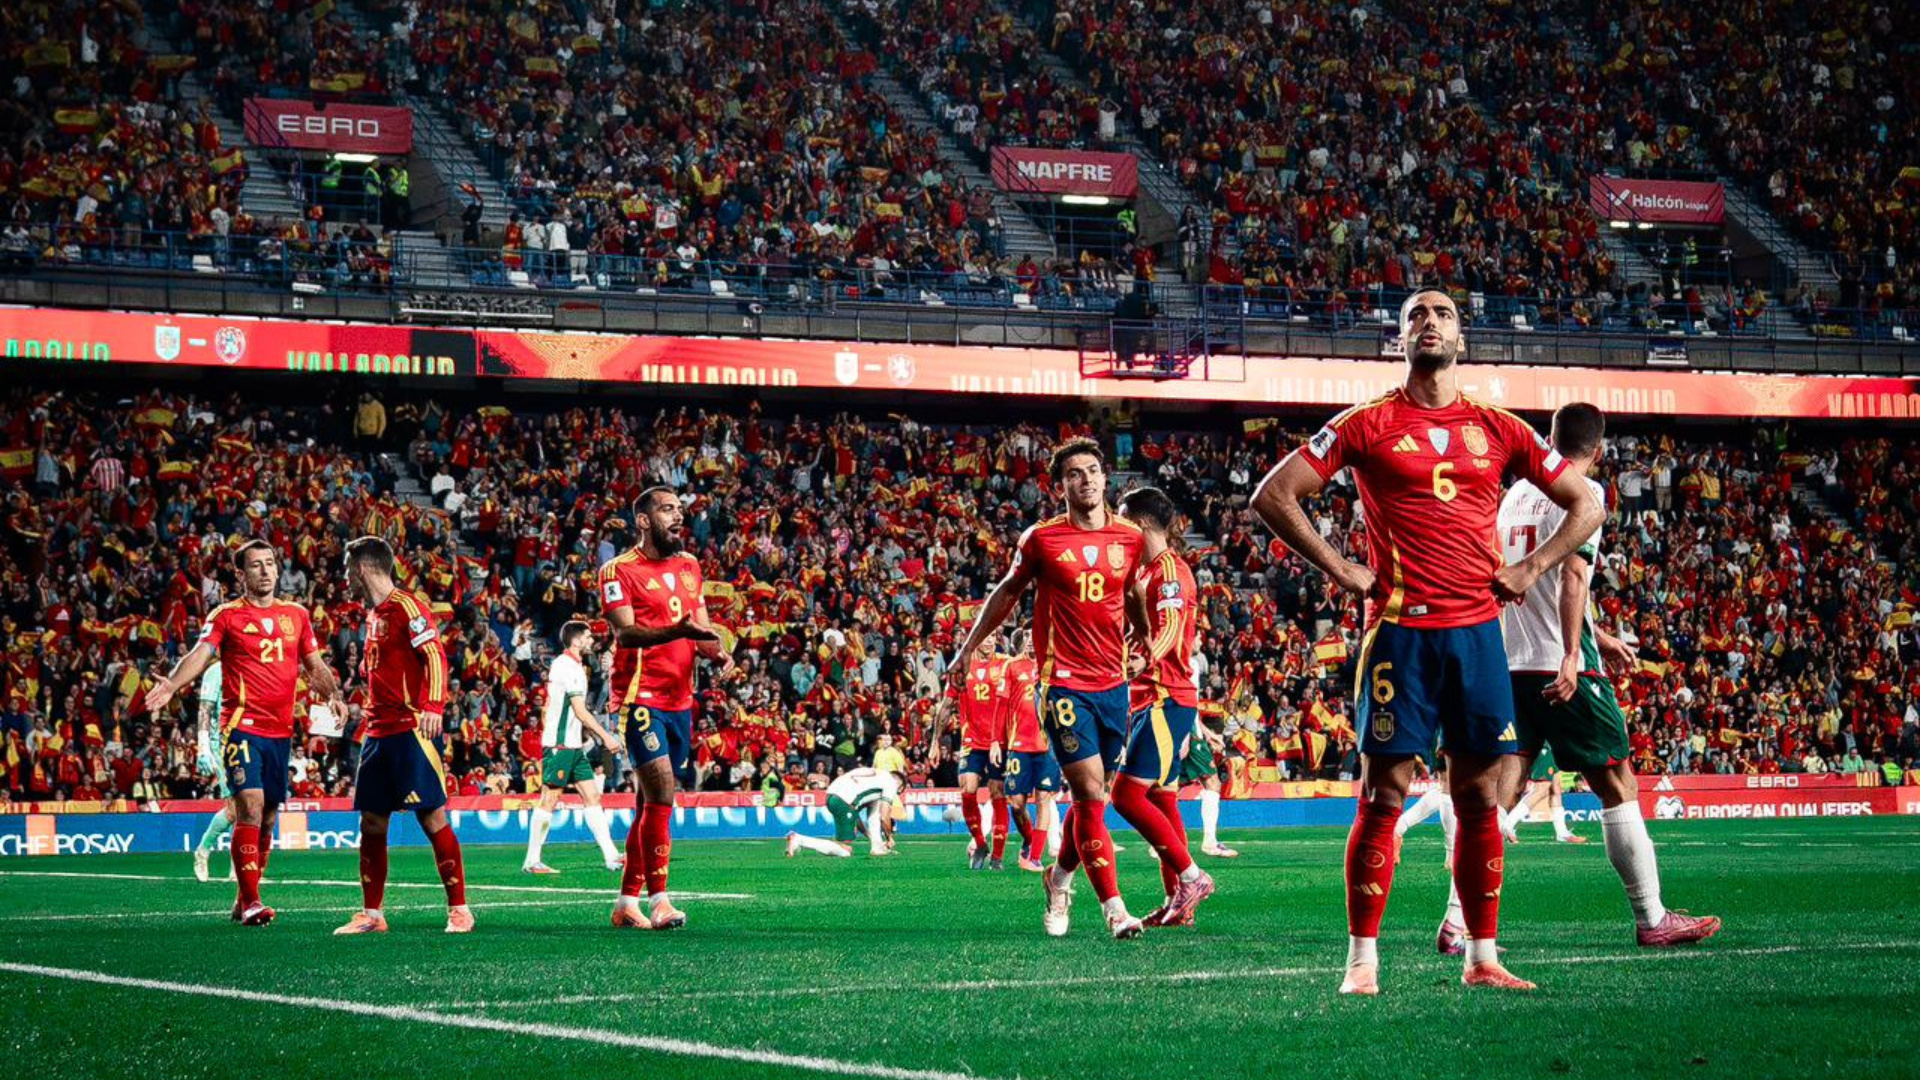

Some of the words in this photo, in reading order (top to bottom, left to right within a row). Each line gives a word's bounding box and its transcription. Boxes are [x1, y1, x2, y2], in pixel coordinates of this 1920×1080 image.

[278, 114, 379, 137] EBRO
[1018, 160, 1113, 182] MAPFRE
[1632, 193, 1684, 209] Halcón
[642, 363, 798, 387] VALLADOLID
[1432, 461, 1457, 502] 6
[1076, 572, 1105, 603] 18
[669, 596, 682, 623] 9
[259, 638, 284, 664] 21
[973, 683, 991, 701] 12
[1024, 683, 1035, 701] 2
[1372, 661, 1395, 705] 6
[634, 707, 651, 732] 9
[227, 740, 251, 767] 21
[1747, 776, 1799, 788] EBRO
[1687, 803, 1777, 819] EUROPEAN
[1780, 801, 1873, 817] QUALIFIERS
[56, 833, 134, 854] POSAY
